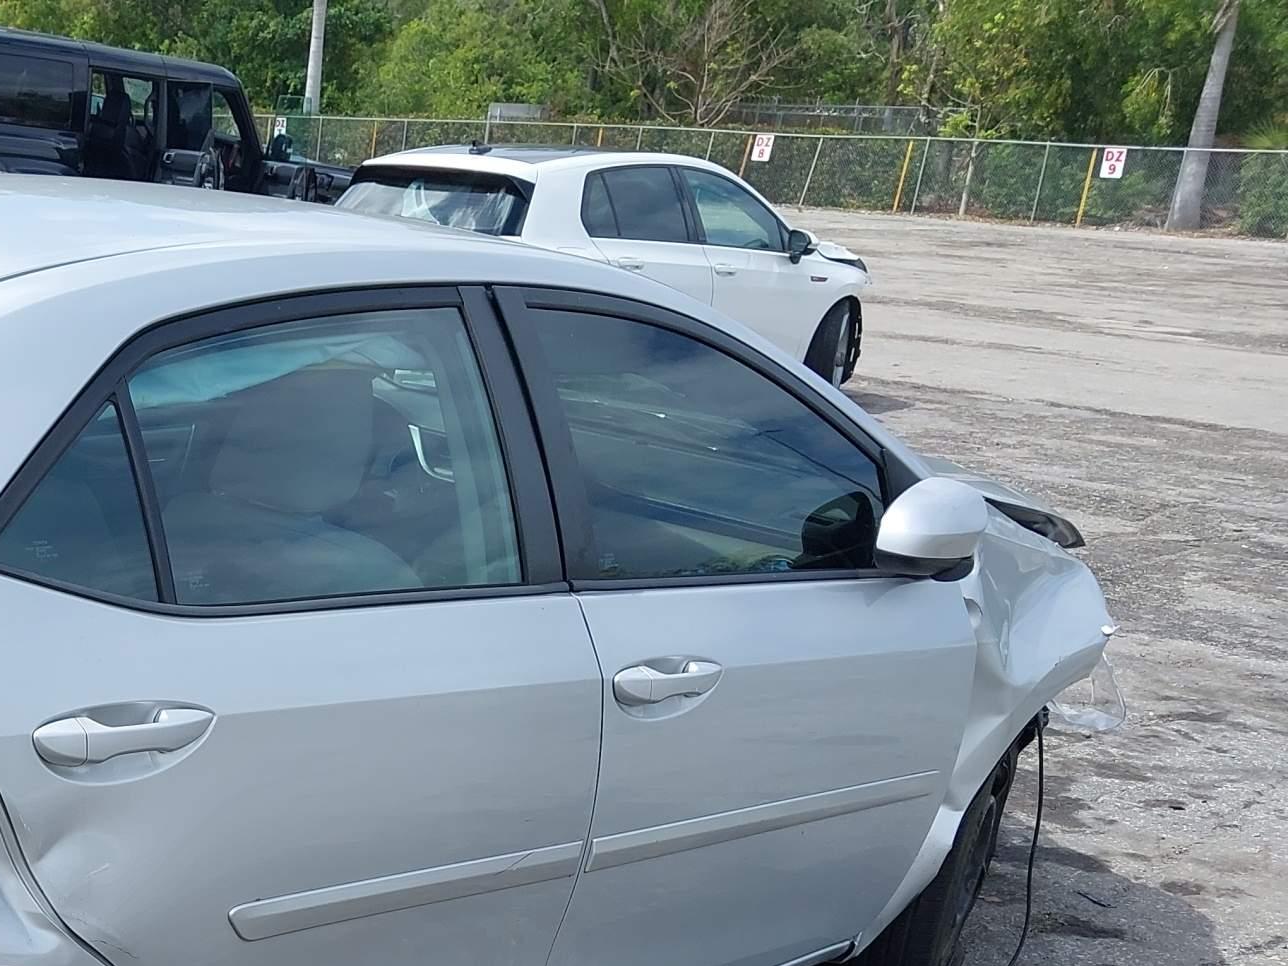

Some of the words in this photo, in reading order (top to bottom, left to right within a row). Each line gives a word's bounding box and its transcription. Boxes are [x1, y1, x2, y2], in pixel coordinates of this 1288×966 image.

[756, 137, 772, 147] DZ
[758, 148, 765, 159] 8
[1105, 151, 1125, 162] DZ
[1108, 163, 1116, 175] 9
